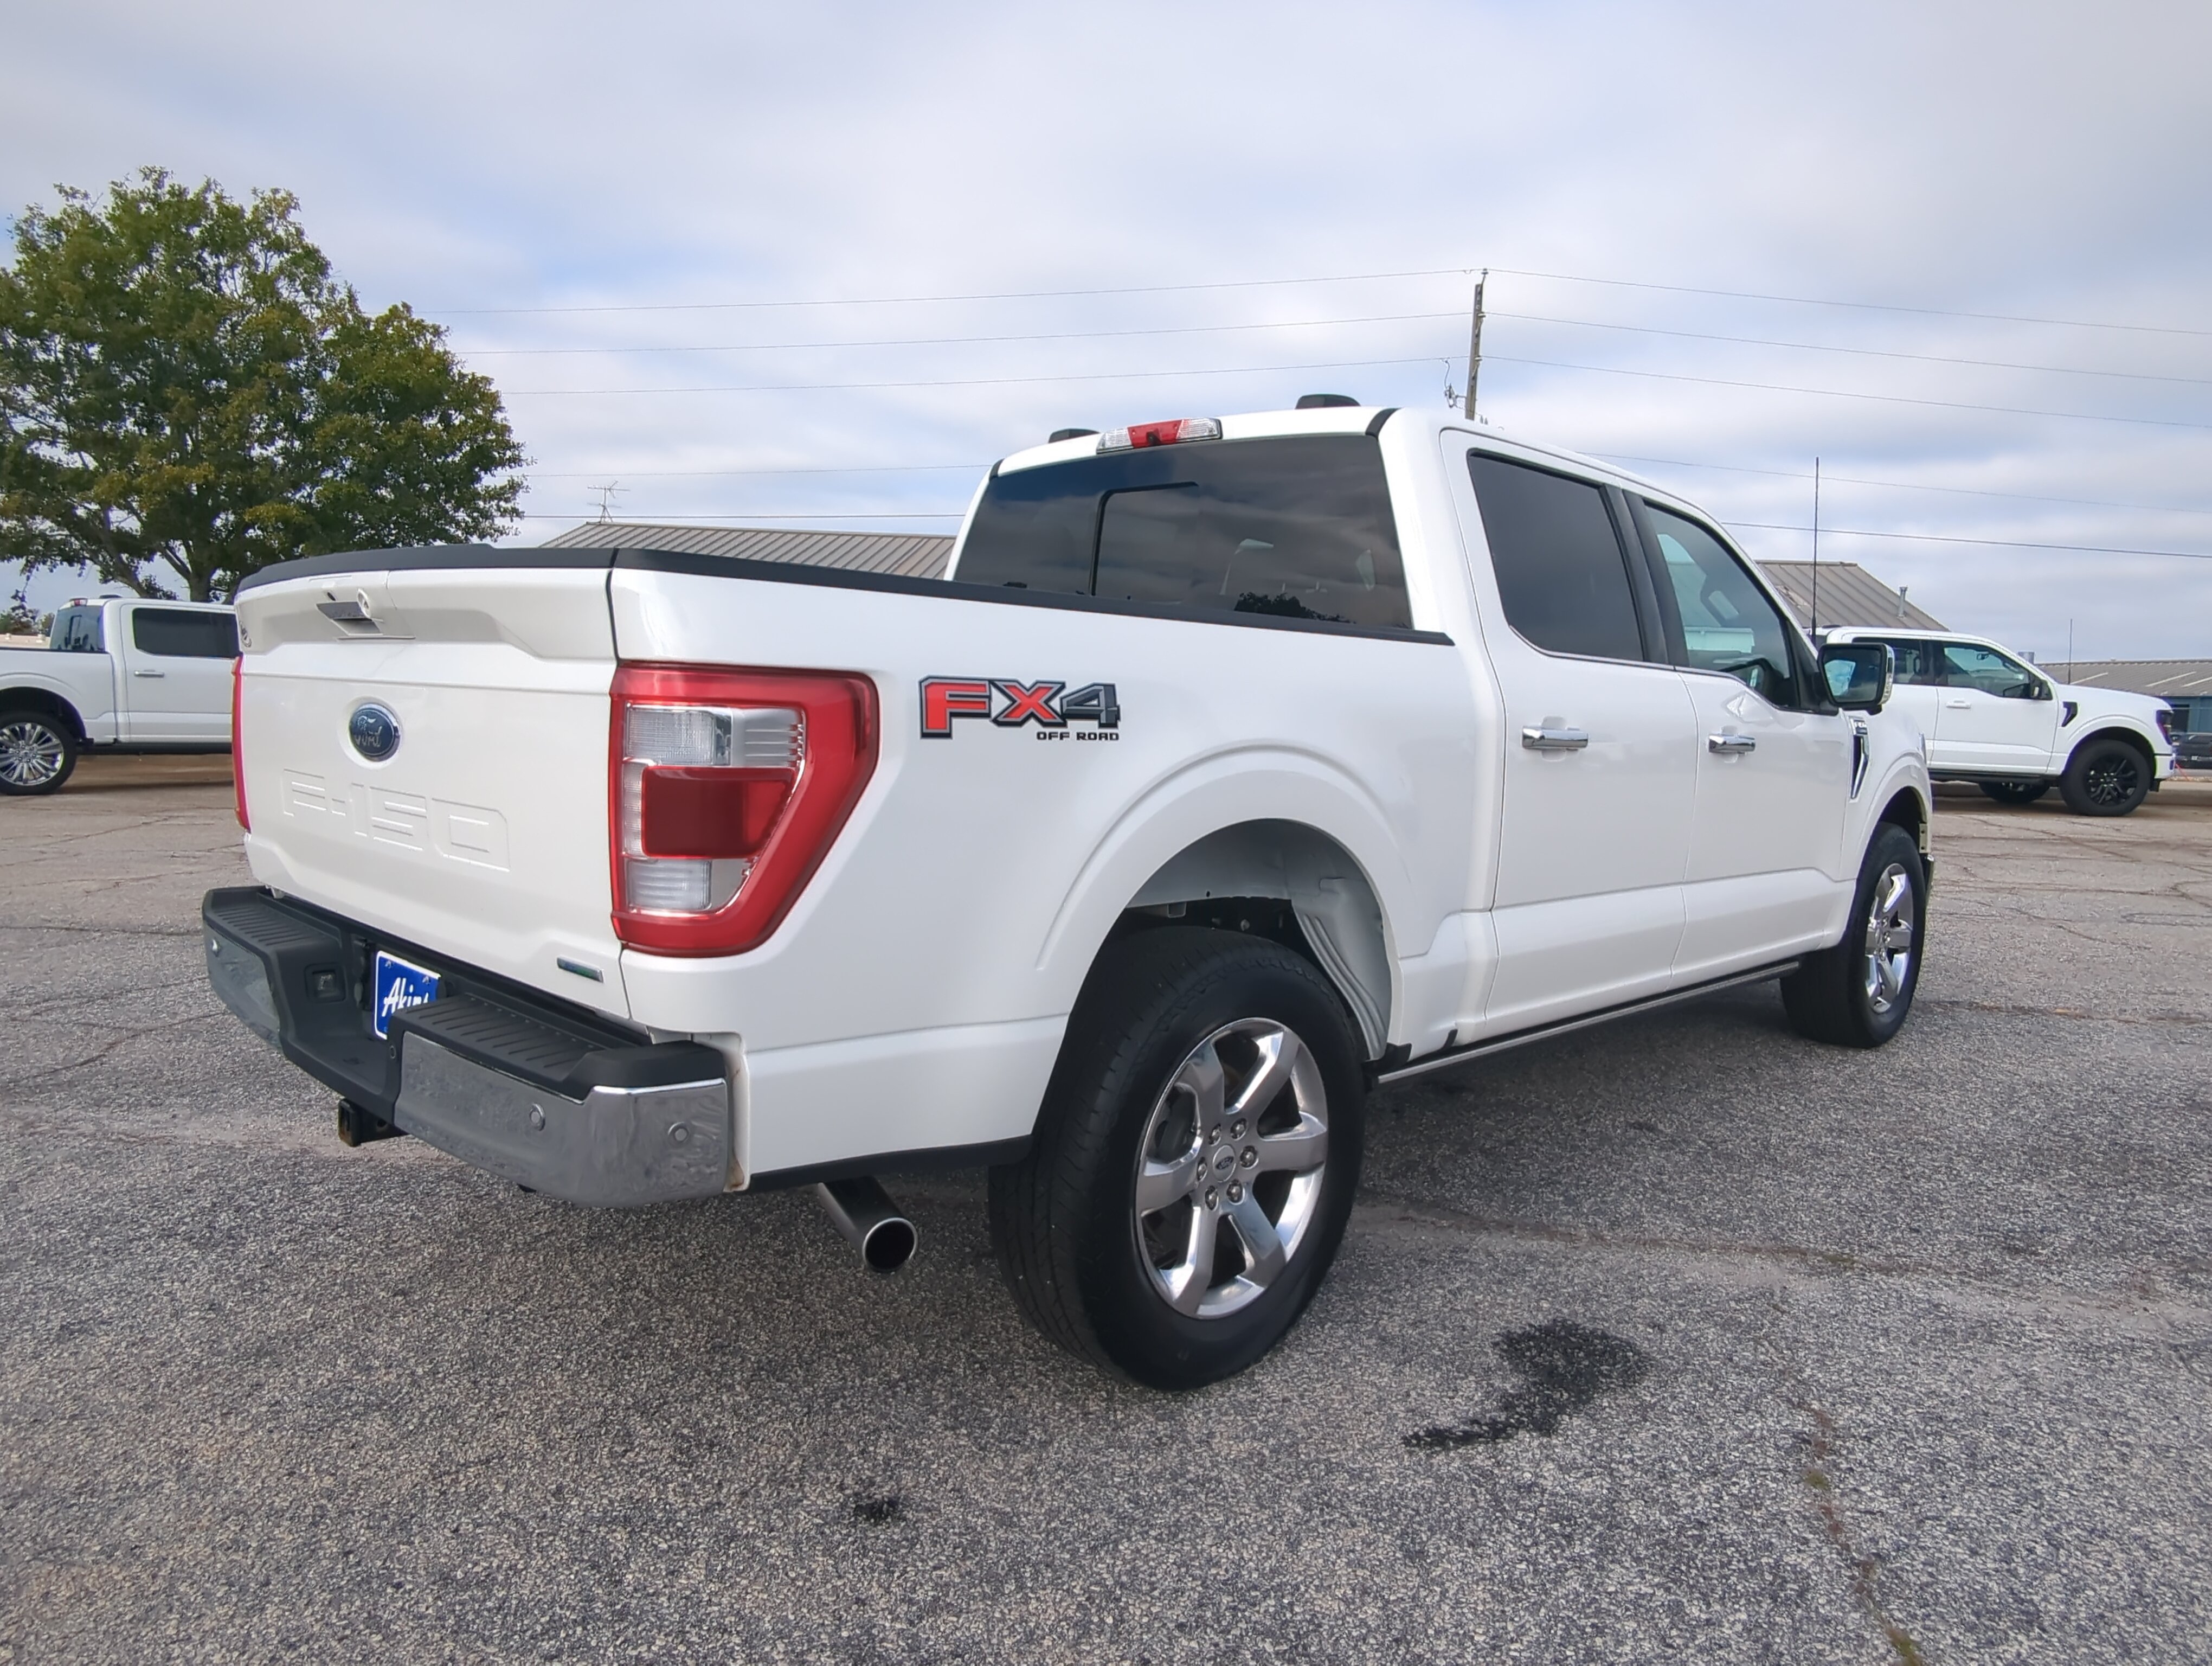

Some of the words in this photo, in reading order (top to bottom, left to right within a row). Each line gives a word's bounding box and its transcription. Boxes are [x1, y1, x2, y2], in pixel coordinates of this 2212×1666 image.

[918, 674, 1121, 739] FX4
[354, 715, 383, 748] Ford
[1036, 731, 1070, 741] OFF
[1076, 732, 1120, 741] ROAD
[280, 768, 511, 873] F-150
[381, 977, 429, 1017] Aki
